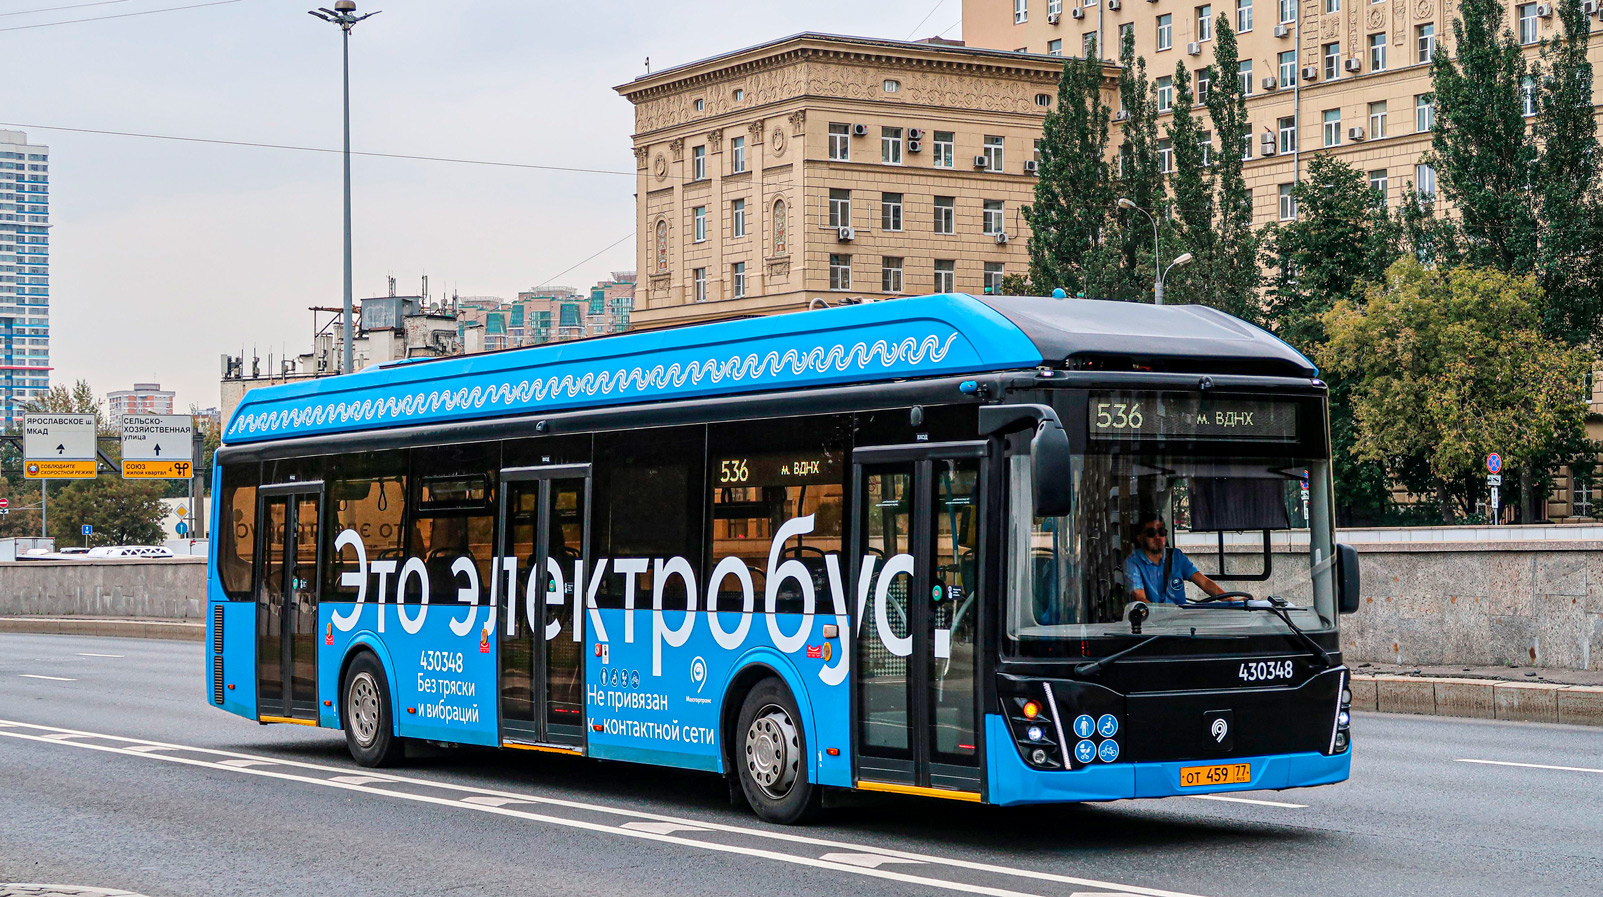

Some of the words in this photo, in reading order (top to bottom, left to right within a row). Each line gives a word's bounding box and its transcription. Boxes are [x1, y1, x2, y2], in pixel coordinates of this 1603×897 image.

[123, 417, 163, 425] СЕЛЬСКО-
[1096, 403, 1143, 429] 536
[1197, 414, 1210, 425] м.
[1216, 411, 1254, 427] ВДНХ
[26, 428, 49, 436] МКАД
[123, 425, 191, 433] ХОЗЯЙСТВЕННАЯ
[720, 459, 749, 482] 536
[793, 460, 820, 476] ВДНХ
[331, 528, 430, 635] Это
[420, 650, 464, 674] 430348
[1238, 661, 1294, 681] 430348
[417, 672, 437, 694] Без
[438, 679, 476, 699] тряски
[587, 684, 605, 706] Не
[607, 691, 668, 713] привязан
[417, 702, 425, 717] и
[426, 699, 480, 725] вибраций
[587, 717, 596, 733] к
[603, 718, 680, 742] контактной
[682, 725, 715, 745] сети
[1186, 771, 1201, 784] ОТ
[1206, 767, 1229, 782] 459
[1235, 765, 1247, 777] 77
